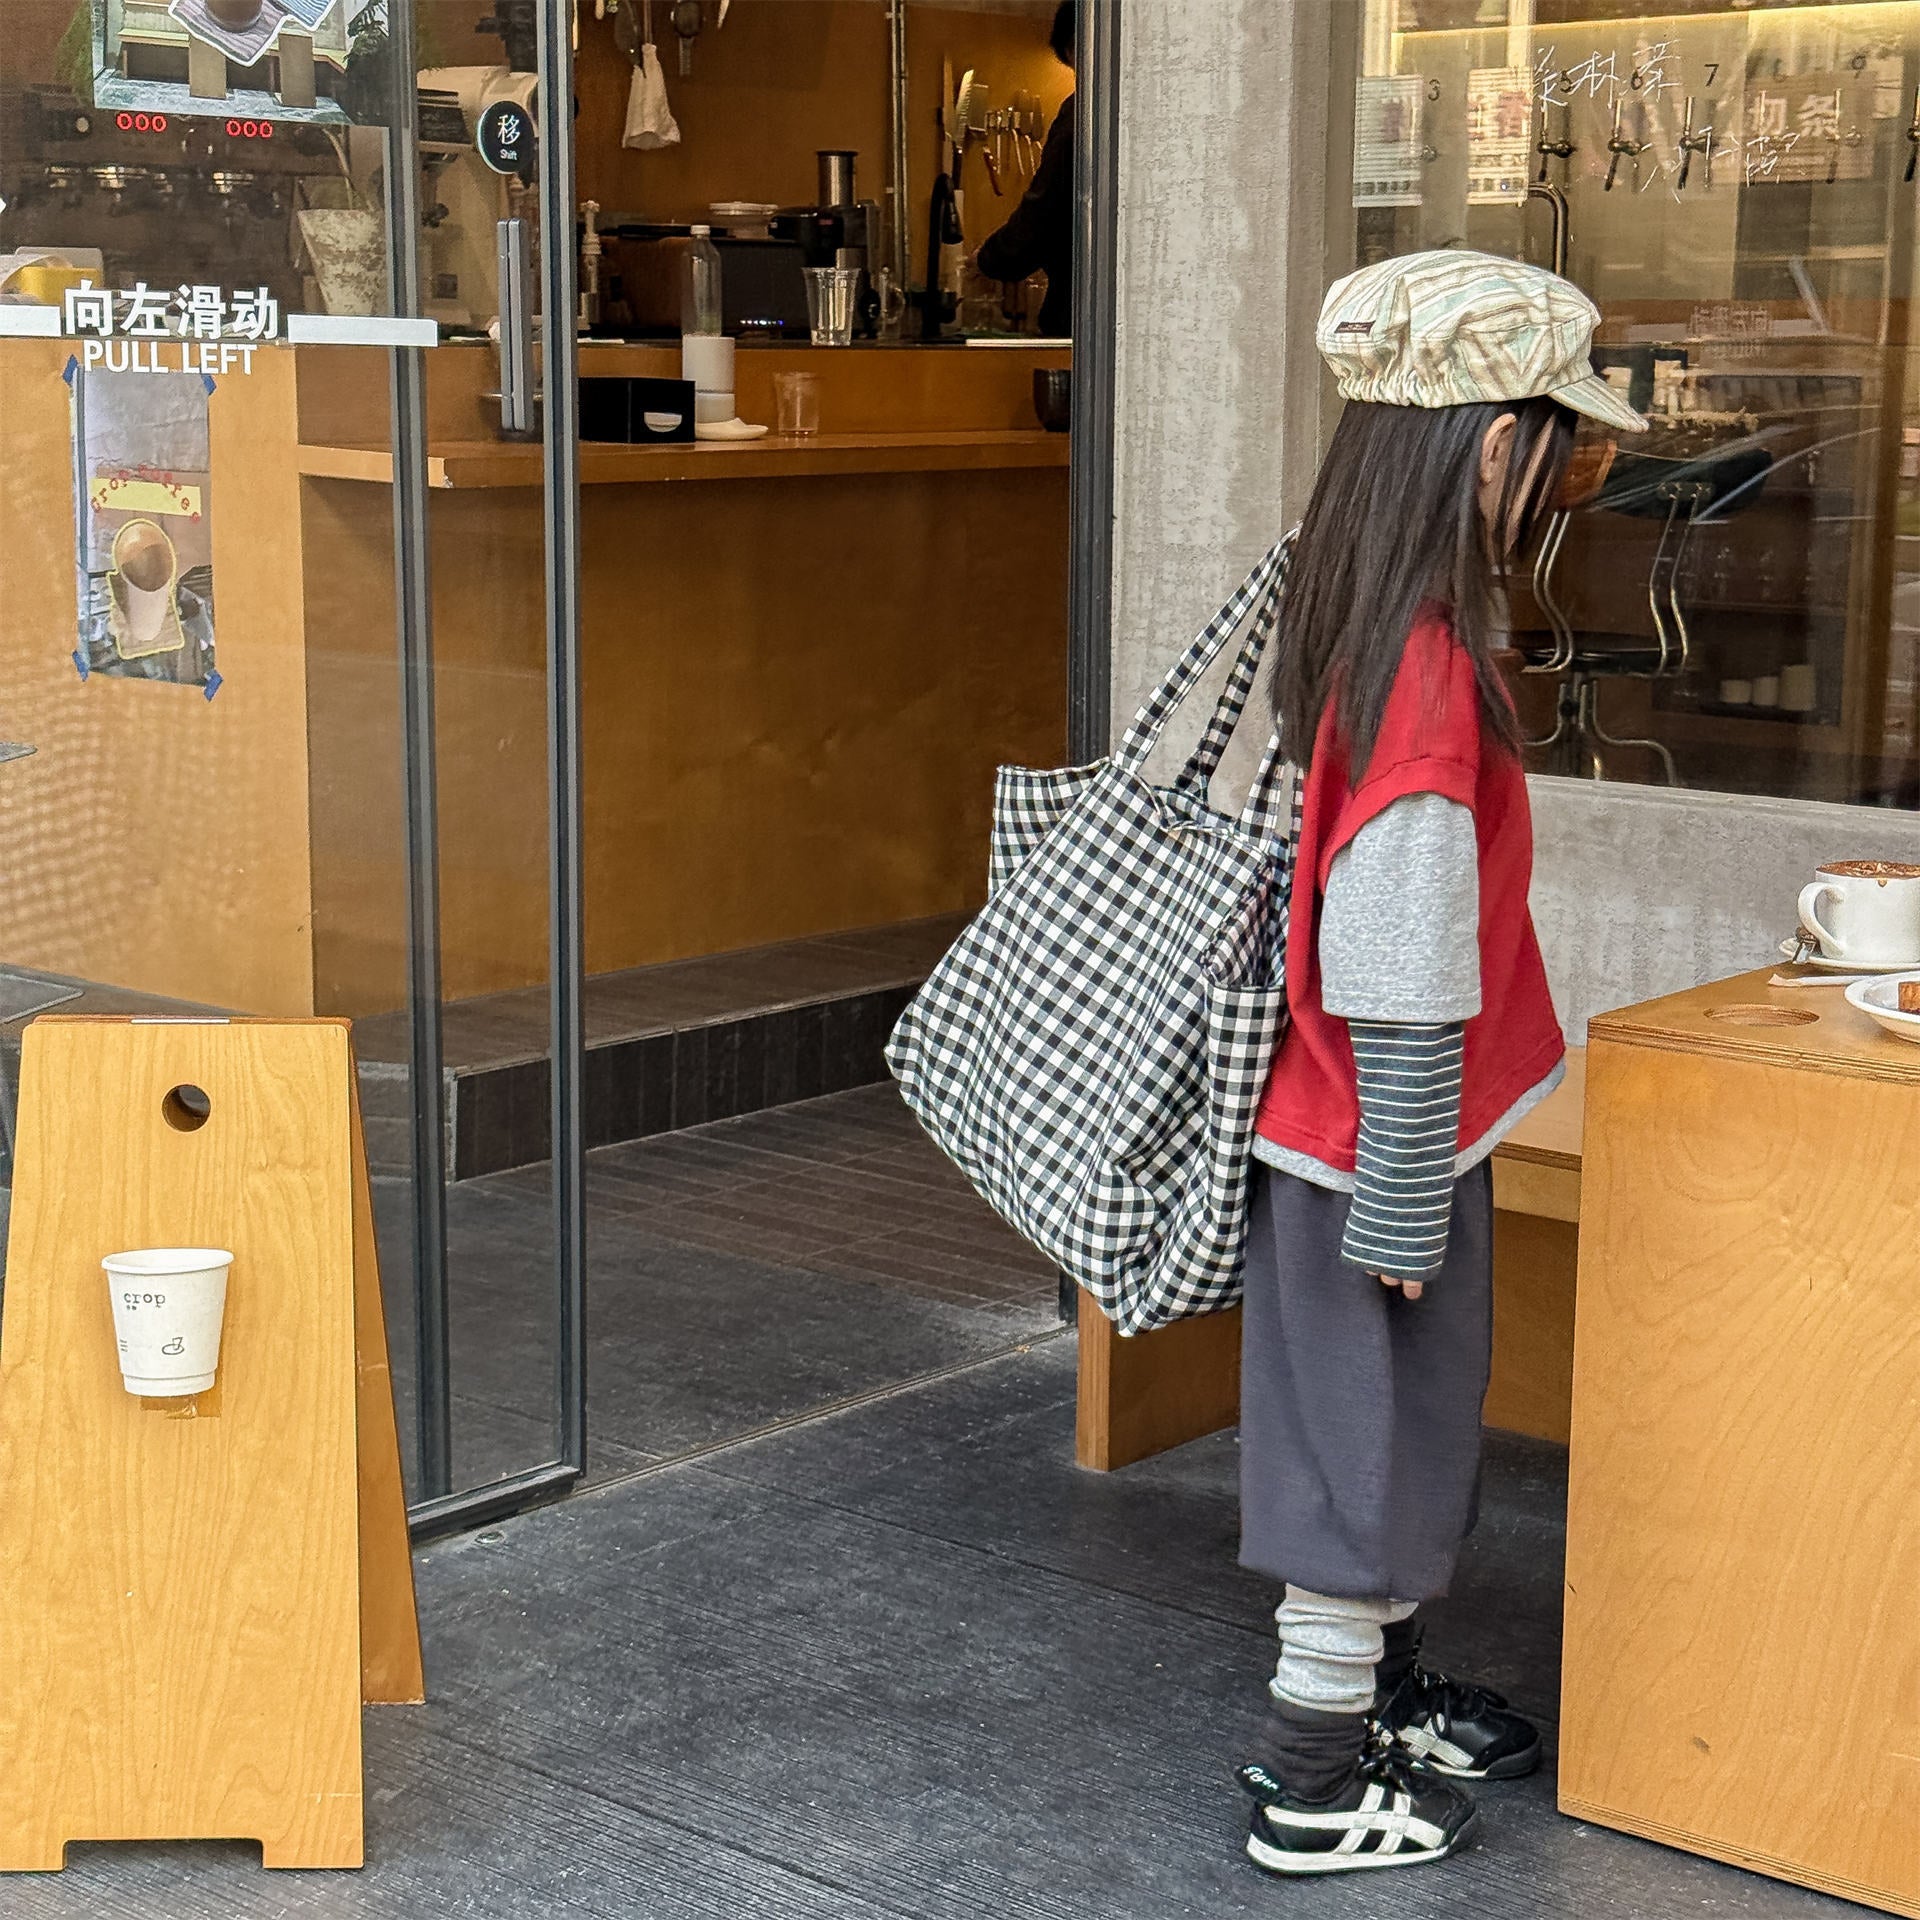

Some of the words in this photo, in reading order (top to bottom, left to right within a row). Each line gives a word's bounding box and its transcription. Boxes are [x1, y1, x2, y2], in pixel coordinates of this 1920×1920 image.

[1427, 78, 1441, 102] 3
[1703, 63, 1720, 88] 7
[115, 111, 168, 133] 000
[225, 119, 274, 139] 000
[497, 113, 521, 145] 移
[500, 148, 518, 161] Shift
[64, 279, 278, 341] 向左滑动
[83, 339, 169, 374] PULL
[182, 341, 258, 375] LEFT
[123, 1292, 166, 1308] crop
